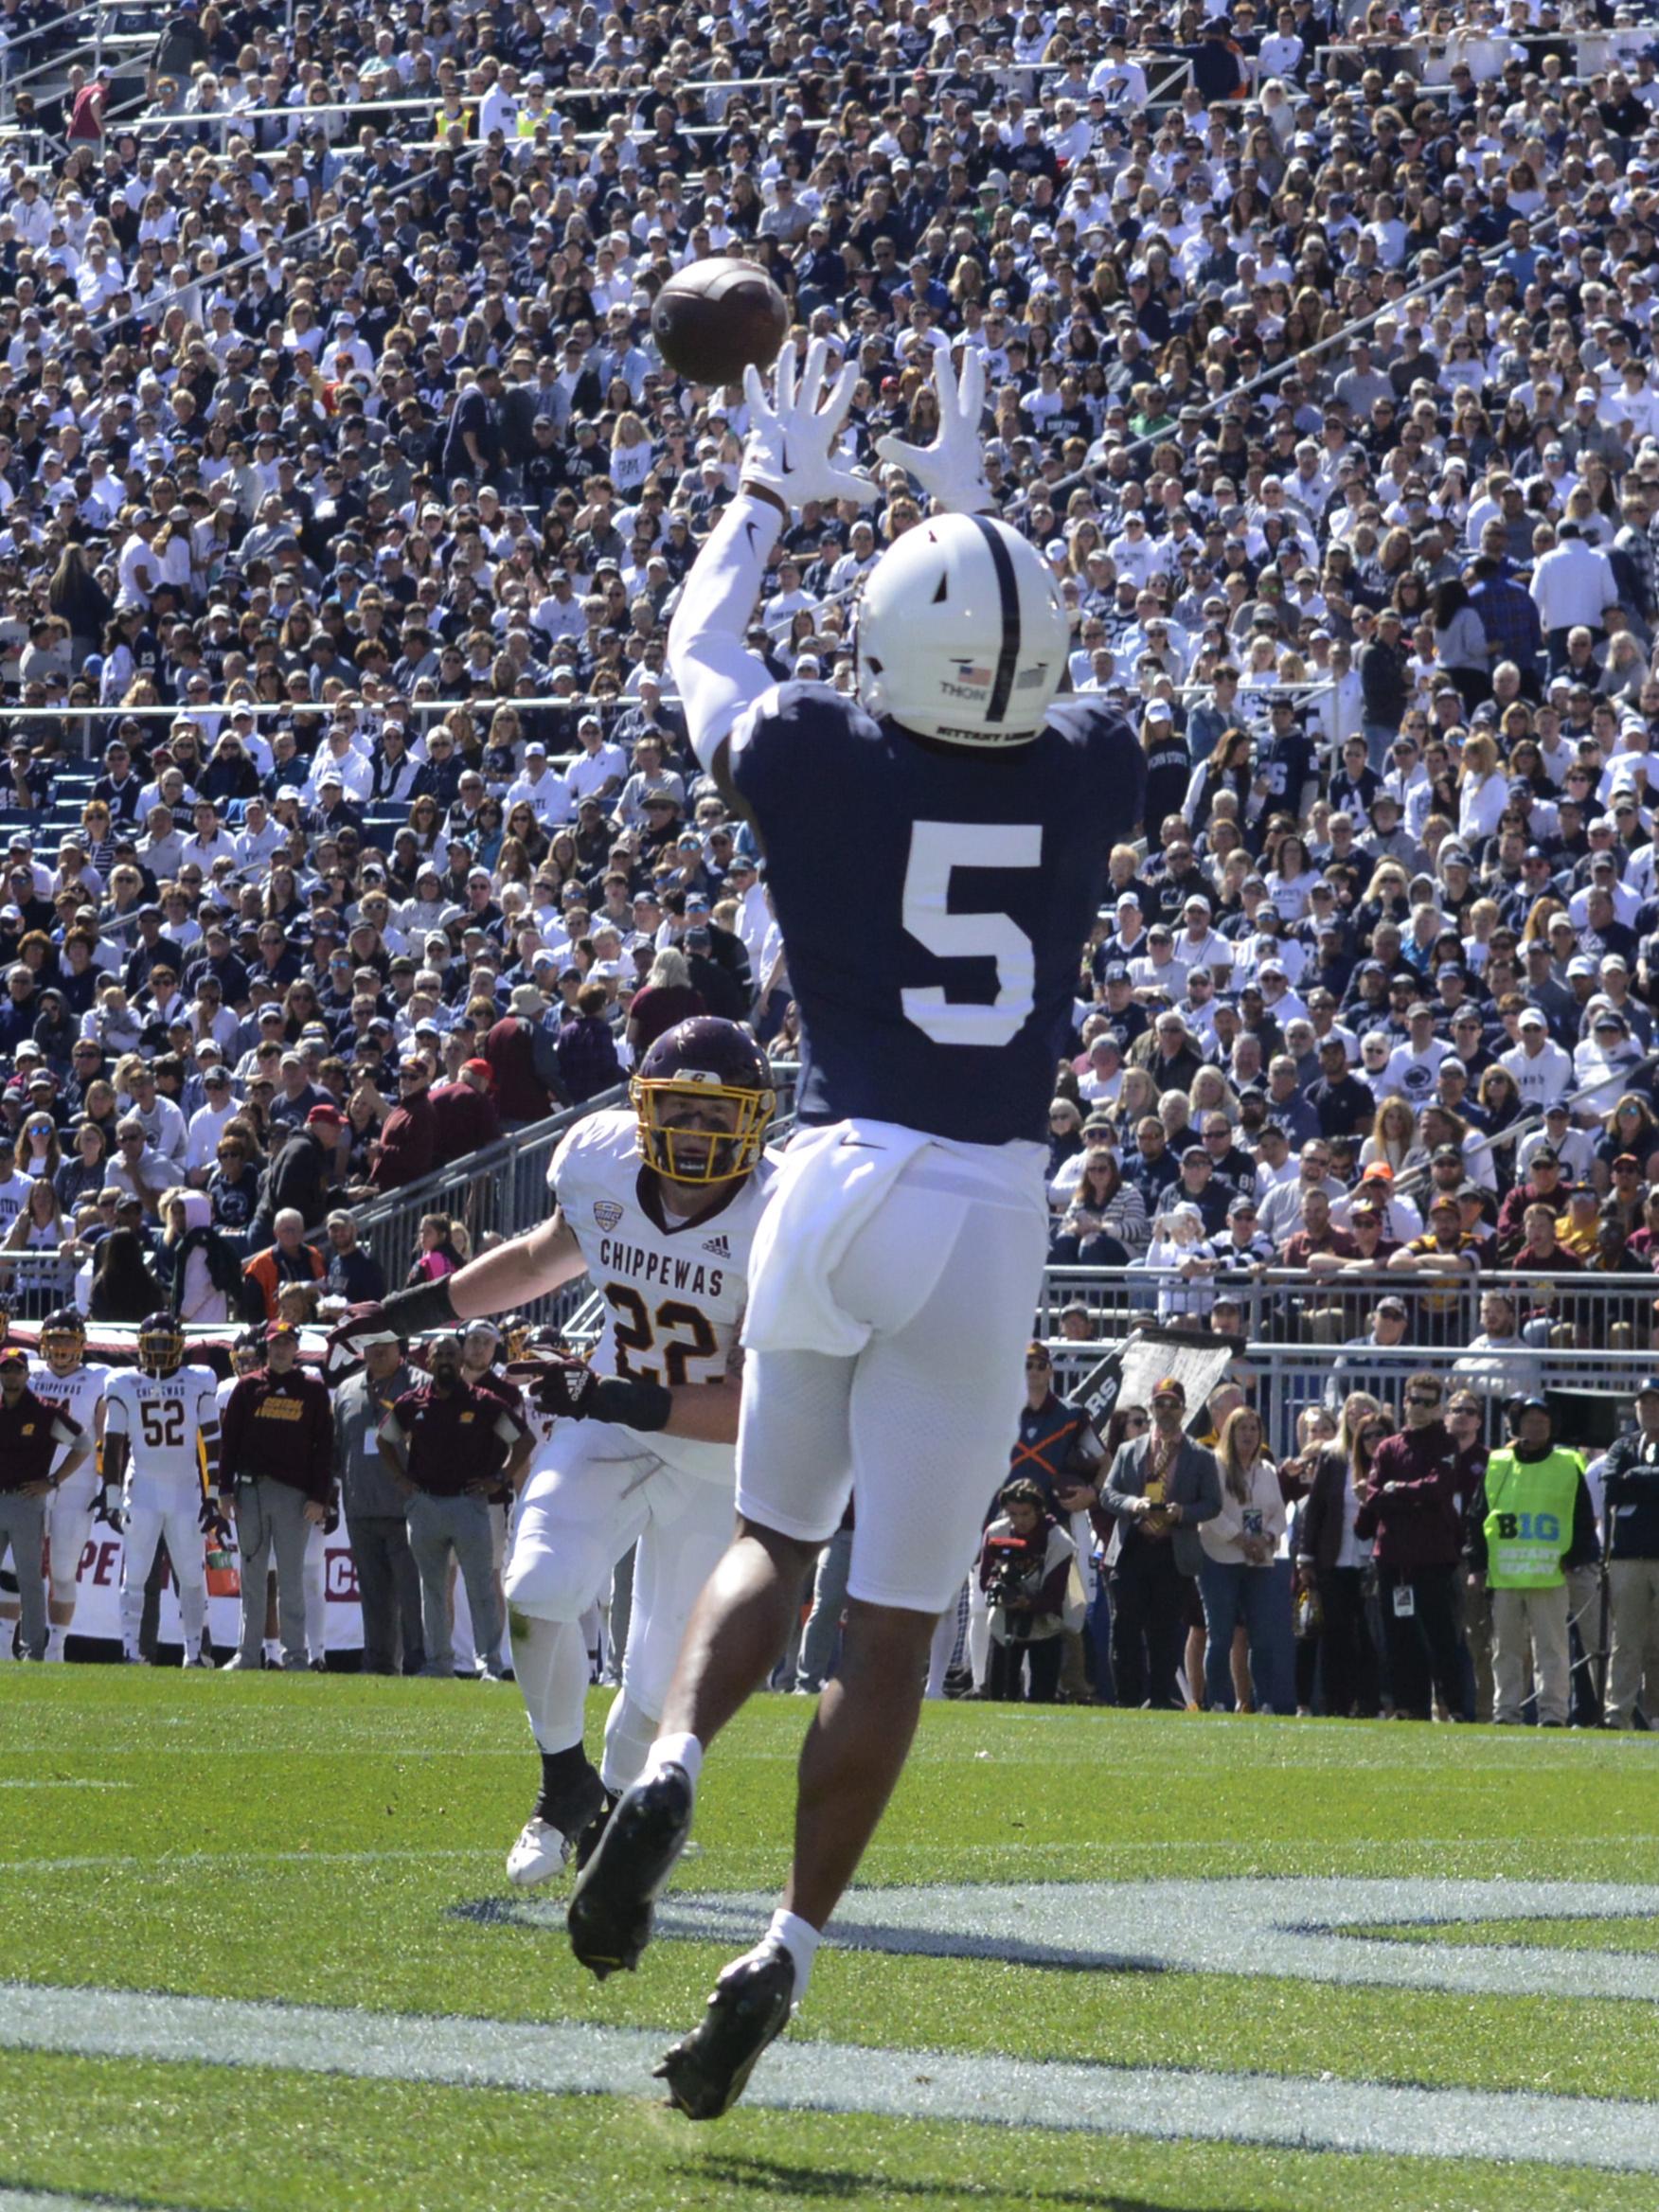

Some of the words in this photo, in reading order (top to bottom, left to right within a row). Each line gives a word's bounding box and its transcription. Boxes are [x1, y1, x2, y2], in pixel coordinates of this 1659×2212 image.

[940, 681, 987, 702] THON
[901, 820, 1043, 1046] 5
[600, 1239, 723, 1297] CHIPPEWAS
[603, 1281, 724, 1387] 22
[141, 1400, 185, 1447] 52
